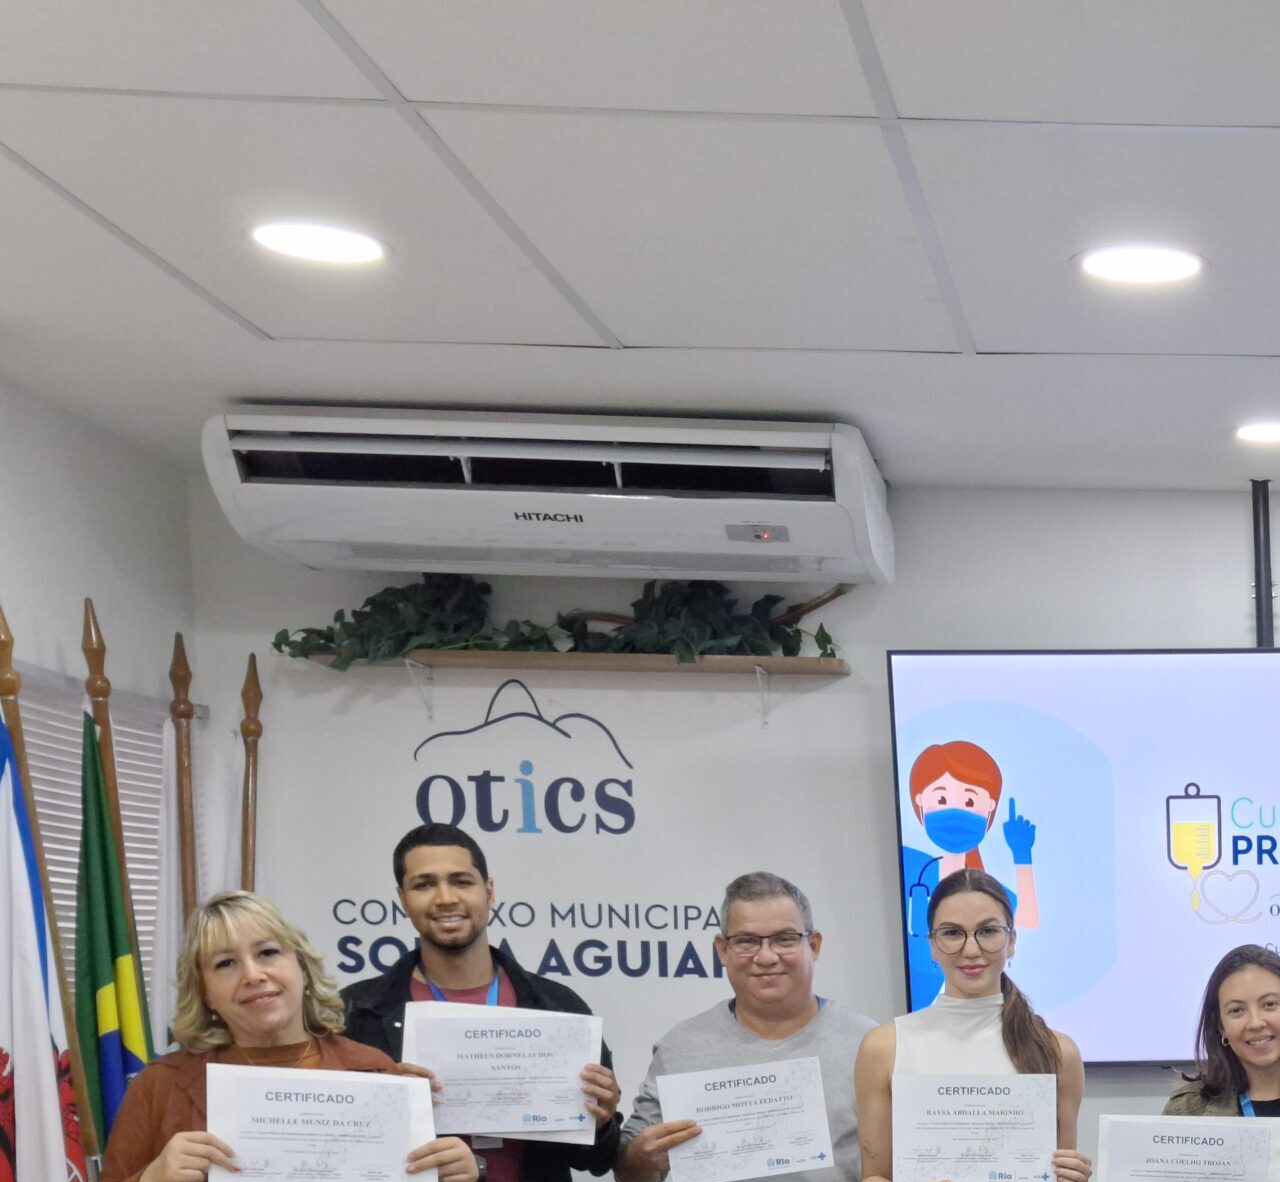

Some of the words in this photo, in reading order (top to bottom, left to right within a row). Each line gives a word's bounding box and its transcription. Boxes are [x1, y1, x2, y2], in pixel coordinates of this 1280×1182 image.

[514, 511, 584, 523] HITACHI
[415, 760, 635, 834] otics
[332, 899, 535, 928] COMXO
[551, 902, 722, 931] MUNICIPA
[537, 938, 726, 978] AGUIA
[464, 1029, 541, 1039] CERTIFICADO
[704, 1074, 777, 1092] CERTIFICADO
[937, 1086, 1011, 1095] CERTIFICADO
[265, 1091, 355, 1104] CERTIFICADO
[1152, 1135, 1225, 1146] CERTIFICADO
